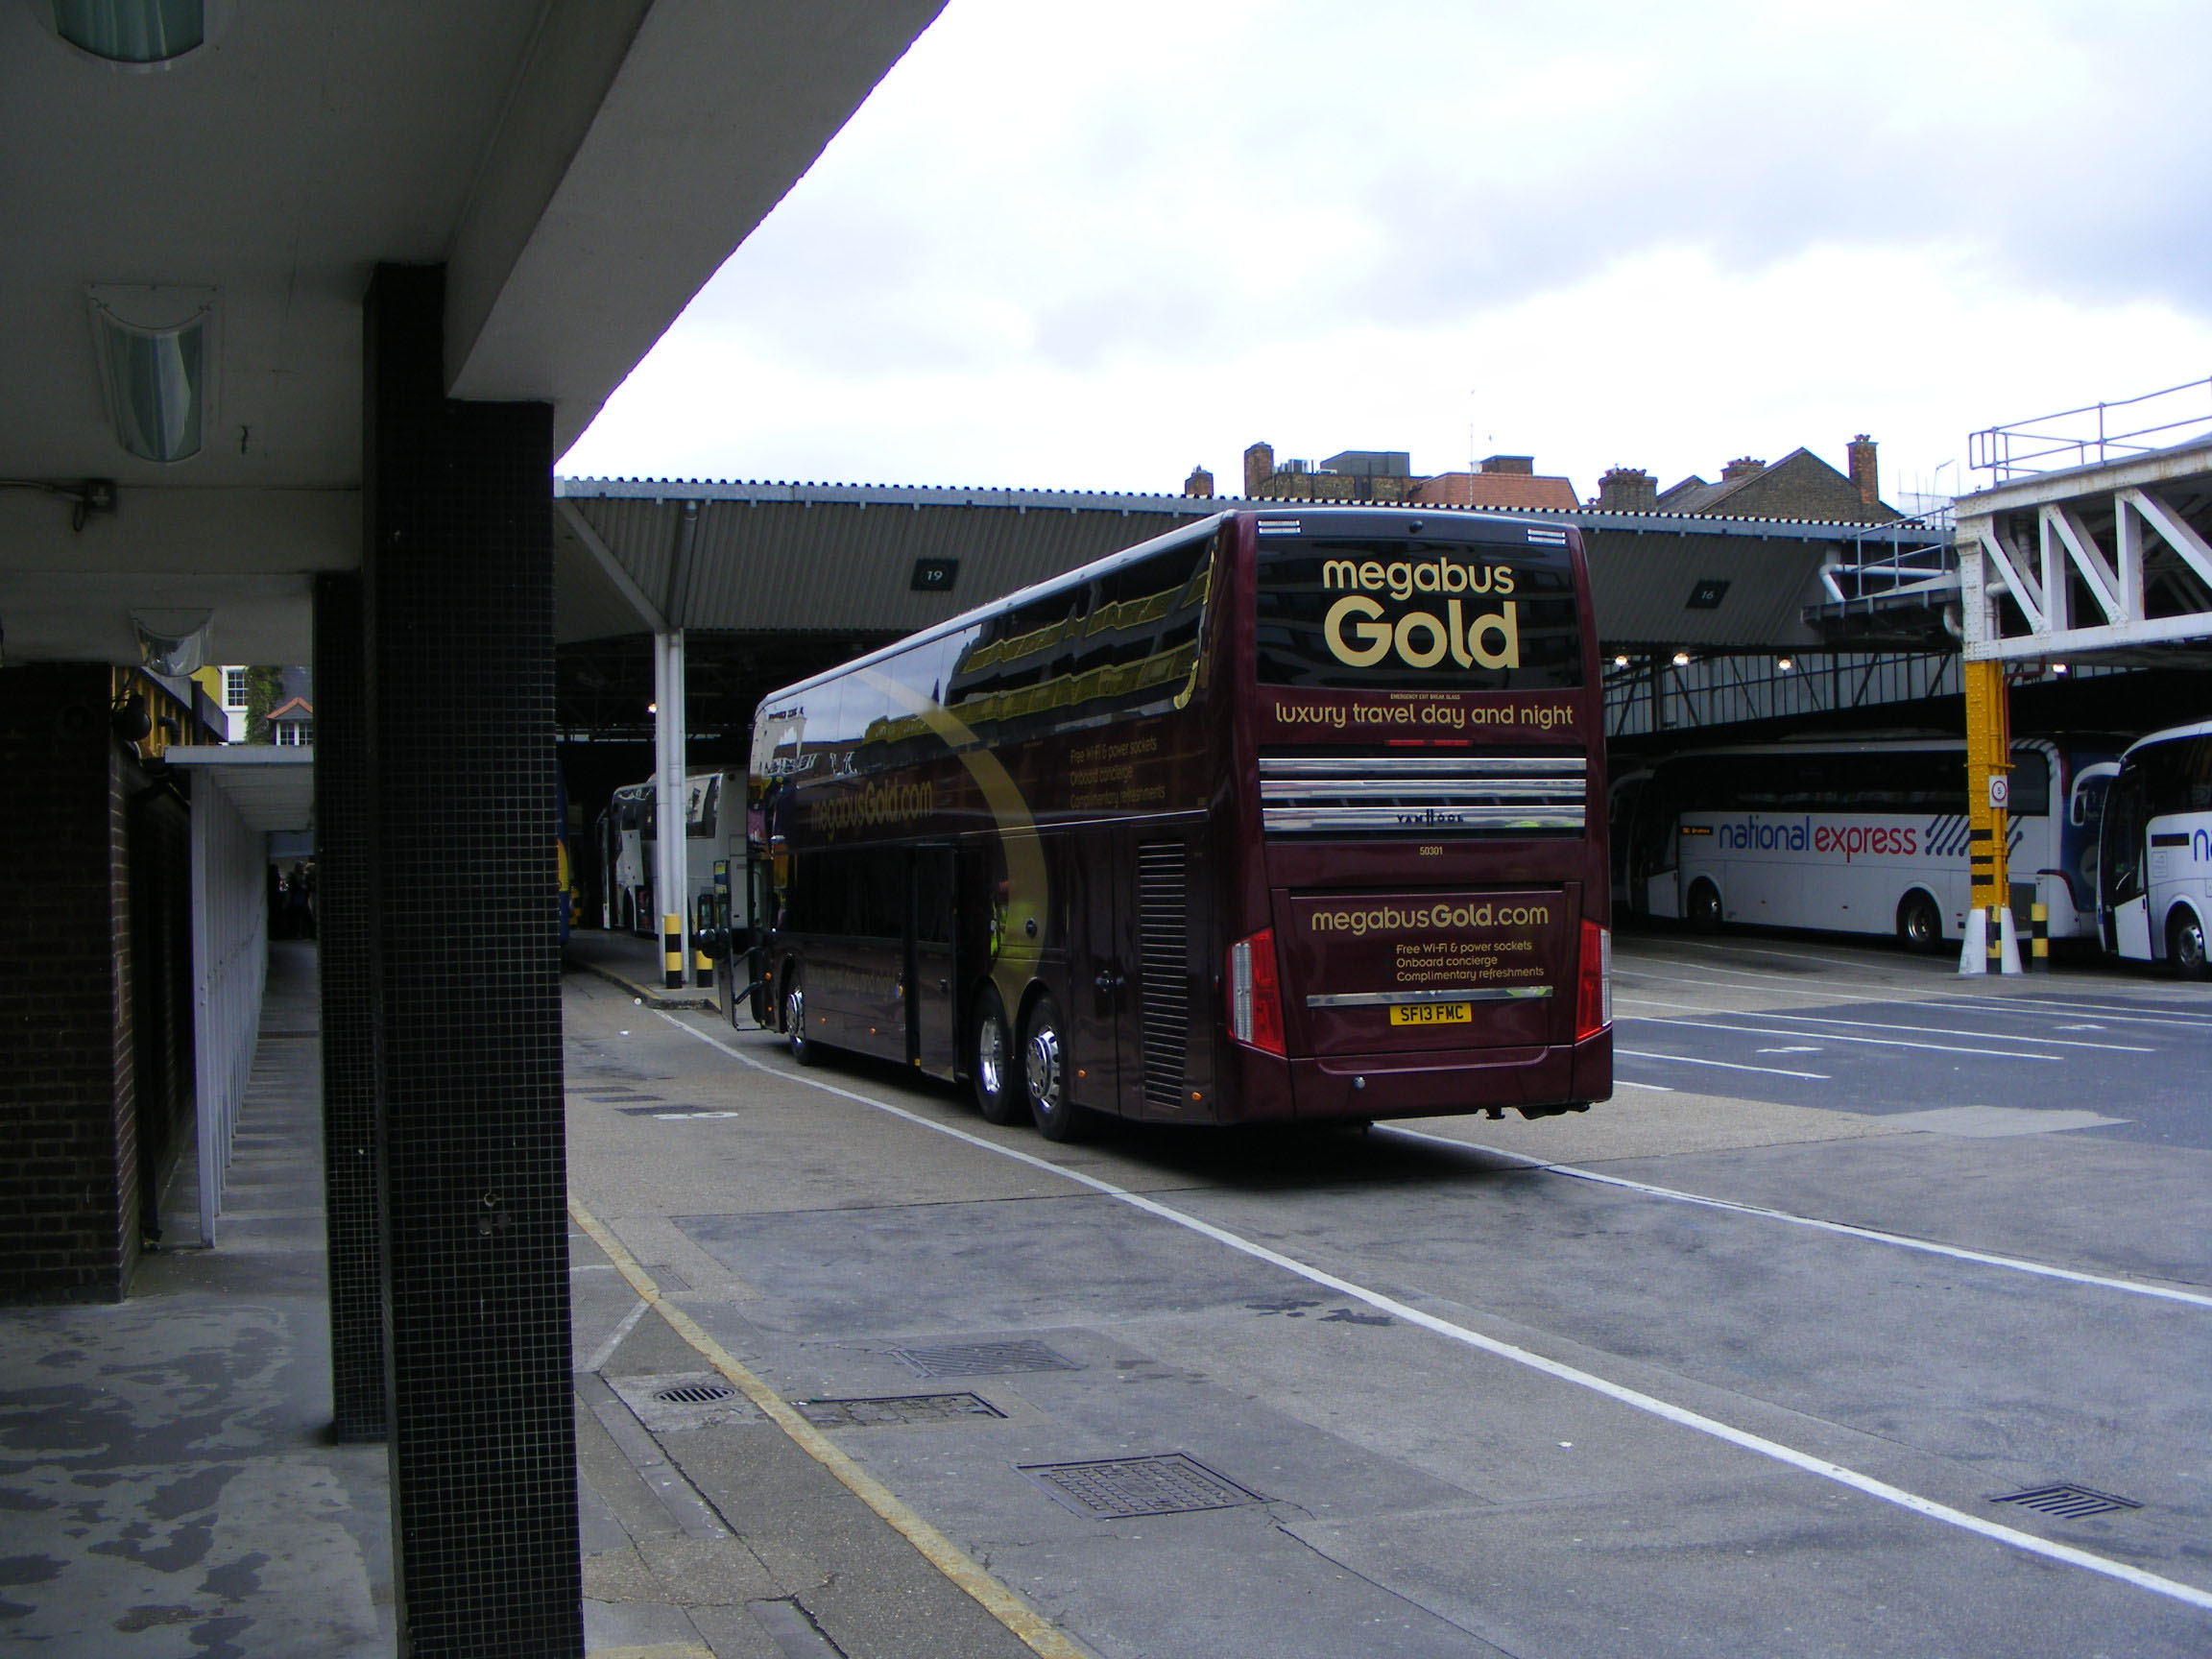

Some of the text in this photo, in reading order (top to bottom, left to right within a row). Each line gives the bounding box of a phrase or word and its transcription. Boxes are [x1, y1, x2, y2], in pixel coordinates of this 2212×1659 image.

[926, 570, 944, 581] 19
[1323, 557, 1515, 600] megabus
[1701, 590, 1714, 599] 16
[1324, 595, 1520, 669] Gold
[1275, 702, 1574, 730] luxury travel day and night
[1719, 814, 1917, 863] national express
[1420, 846, 1443, 855] 50301
[1311, 903, 1550, 935] megabusGold.com
[1396, 941, 1532, 955] Free Wi-Fi & power sockets
[1396, 955, 1498, 968] Onboard concierge
[1397, 967, 1545, 982] Complimentary refreshments
[1401, 1005, 1464, 1022] SF13 FMC
